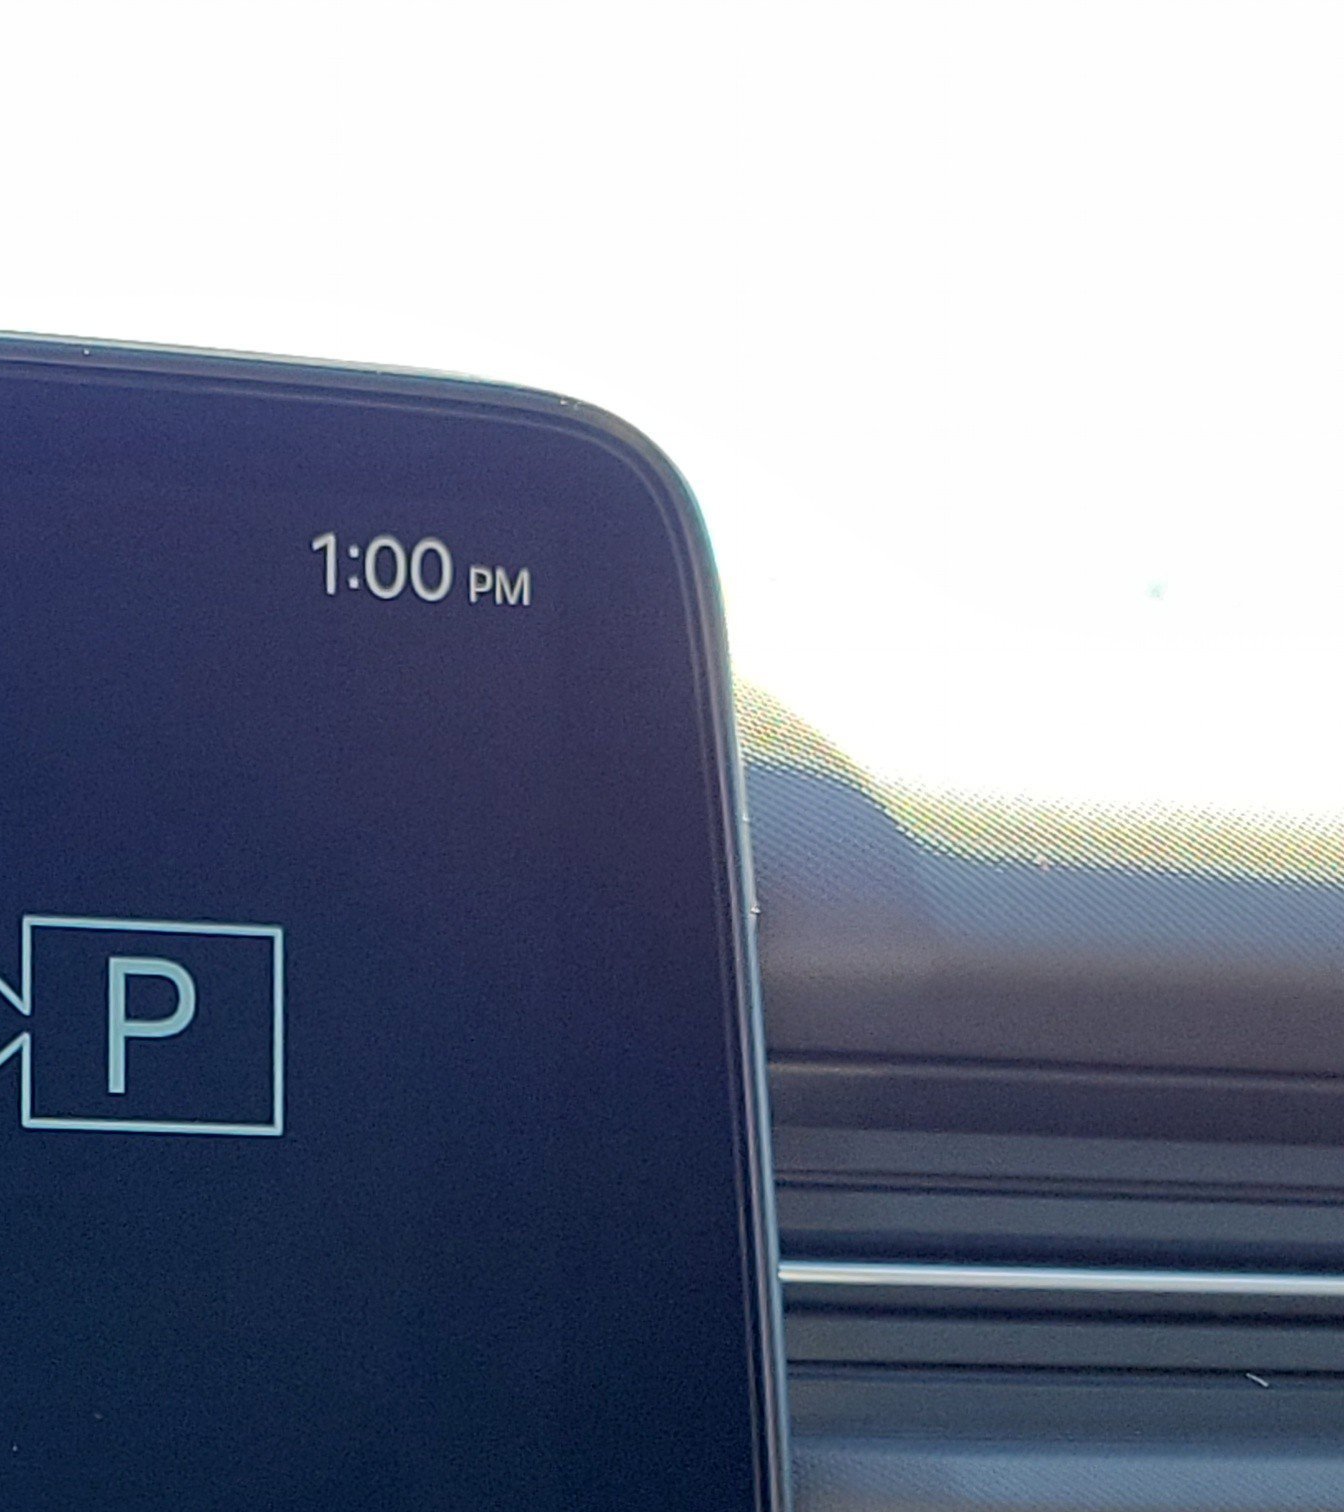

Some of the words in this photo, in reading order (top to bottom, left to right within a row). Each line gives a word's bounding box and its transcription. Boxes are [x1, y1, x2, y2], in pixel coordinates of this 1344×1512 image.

[312, 532, 452, 602] 1:00
[469, 564, 531, 606] PM
[108, 956, 196, 1094] P
